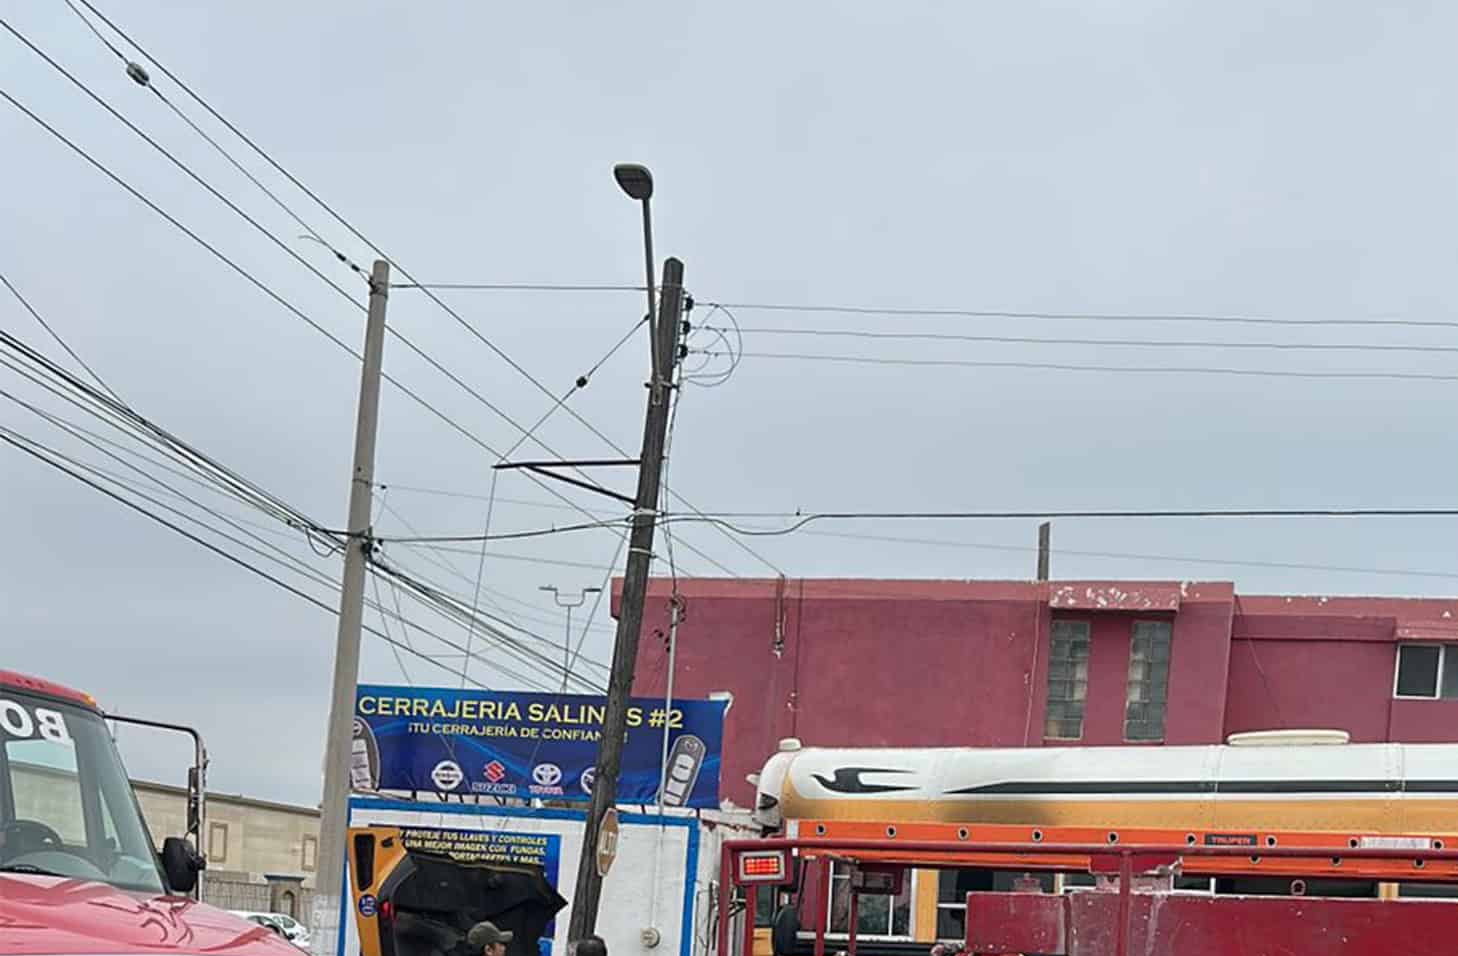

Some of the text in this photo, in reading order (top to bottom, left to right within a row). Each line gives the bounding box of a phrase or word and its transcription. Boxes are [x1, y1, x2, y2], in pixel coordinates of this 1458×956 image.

[358, 696, 684, 729] CERRAJERIA SALINS #2
[520, 727, 540, 738] DE
[542, 728, 628, 743] CONFIAN!
